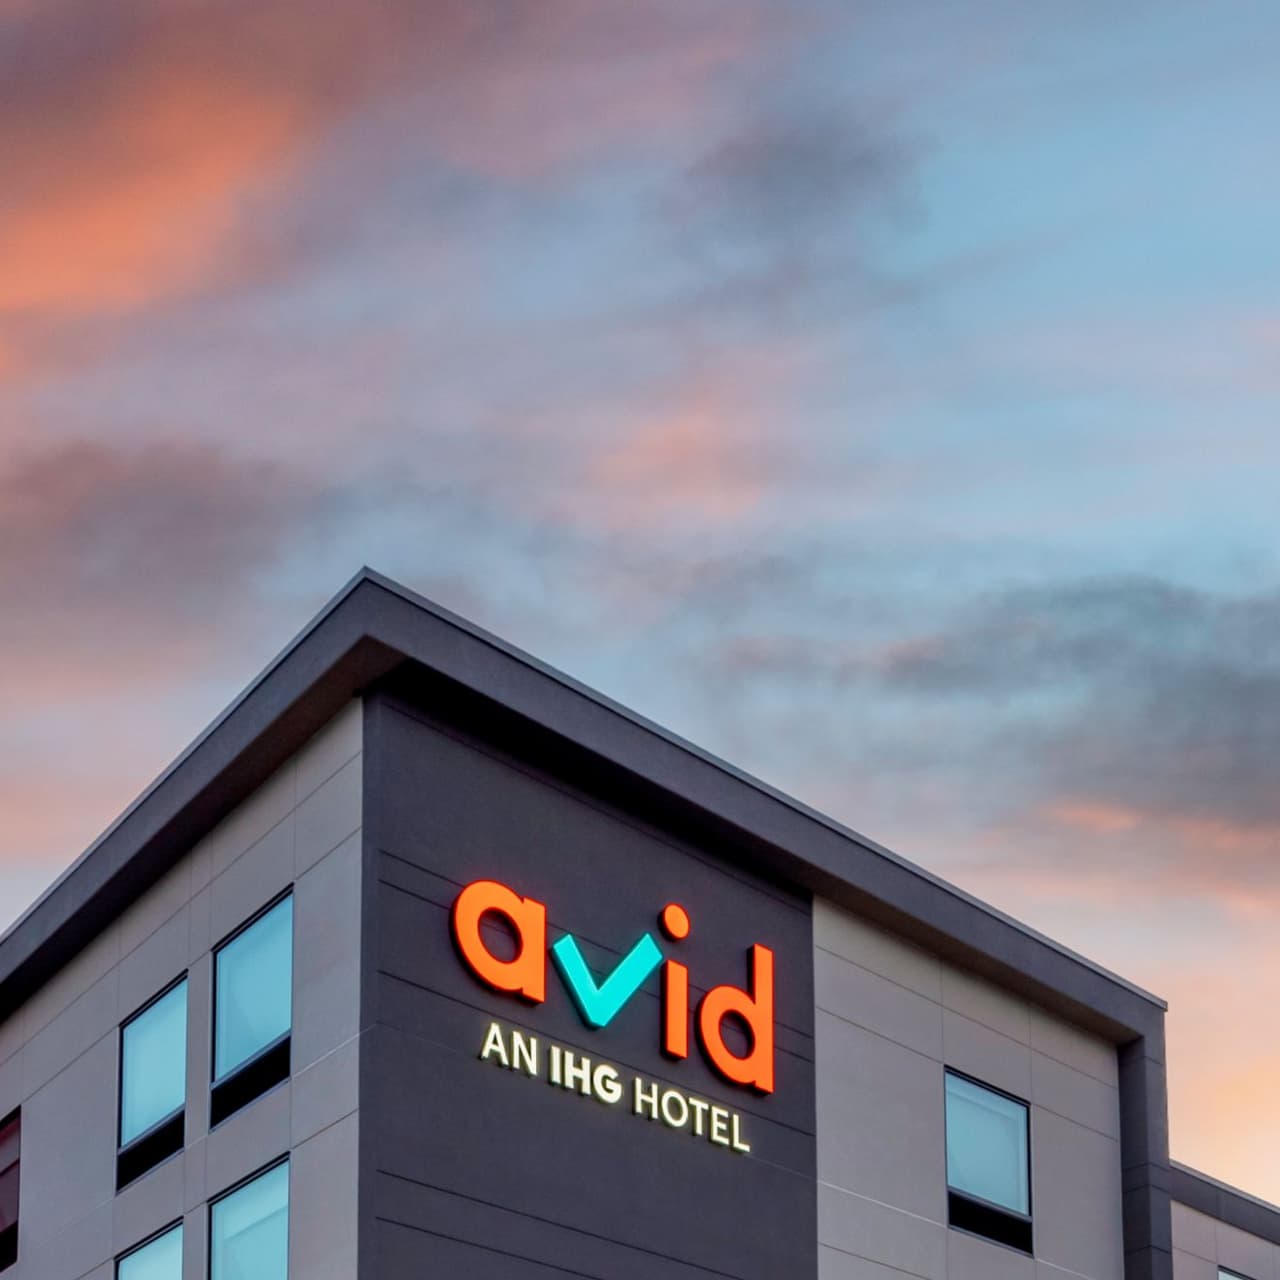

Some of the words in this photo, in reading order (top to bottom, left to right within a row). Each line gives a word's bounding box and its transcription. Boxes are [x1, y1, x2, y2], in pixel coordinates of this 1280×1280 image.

[450, 879, 775, 1094] avid
[481, 1022, 538, 1076] AN
[550, 1045, 622, 1104] IHG
[634, 1076, 751, 1153] HOTEL
